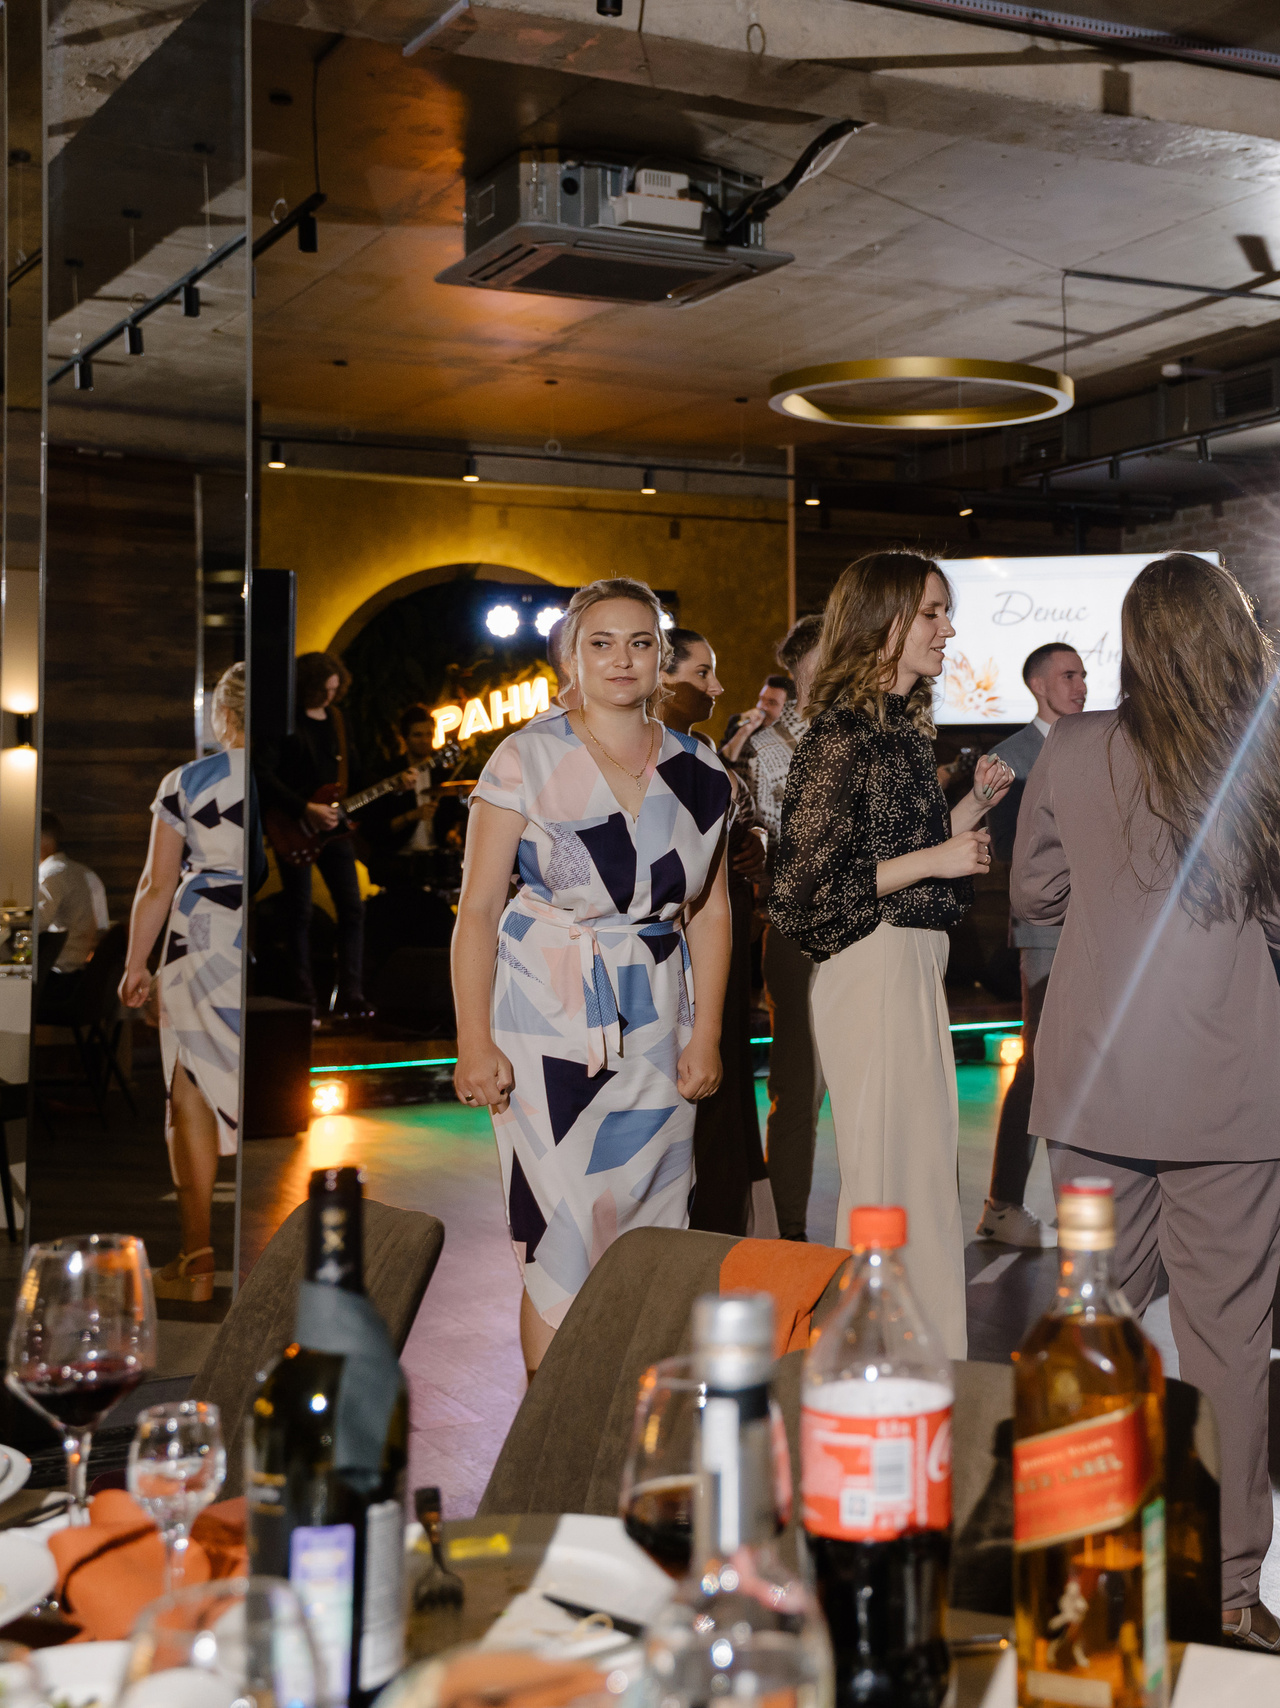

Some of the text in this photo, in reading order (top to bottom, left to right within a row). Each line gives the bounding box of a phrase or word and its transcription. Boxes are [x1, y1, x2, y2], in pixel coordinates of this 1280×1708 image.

[993, 591, 1088, 626] Денис
[1078, 631, 1121, 666] Ан
[431, 677, 550, 749] РАНИ
